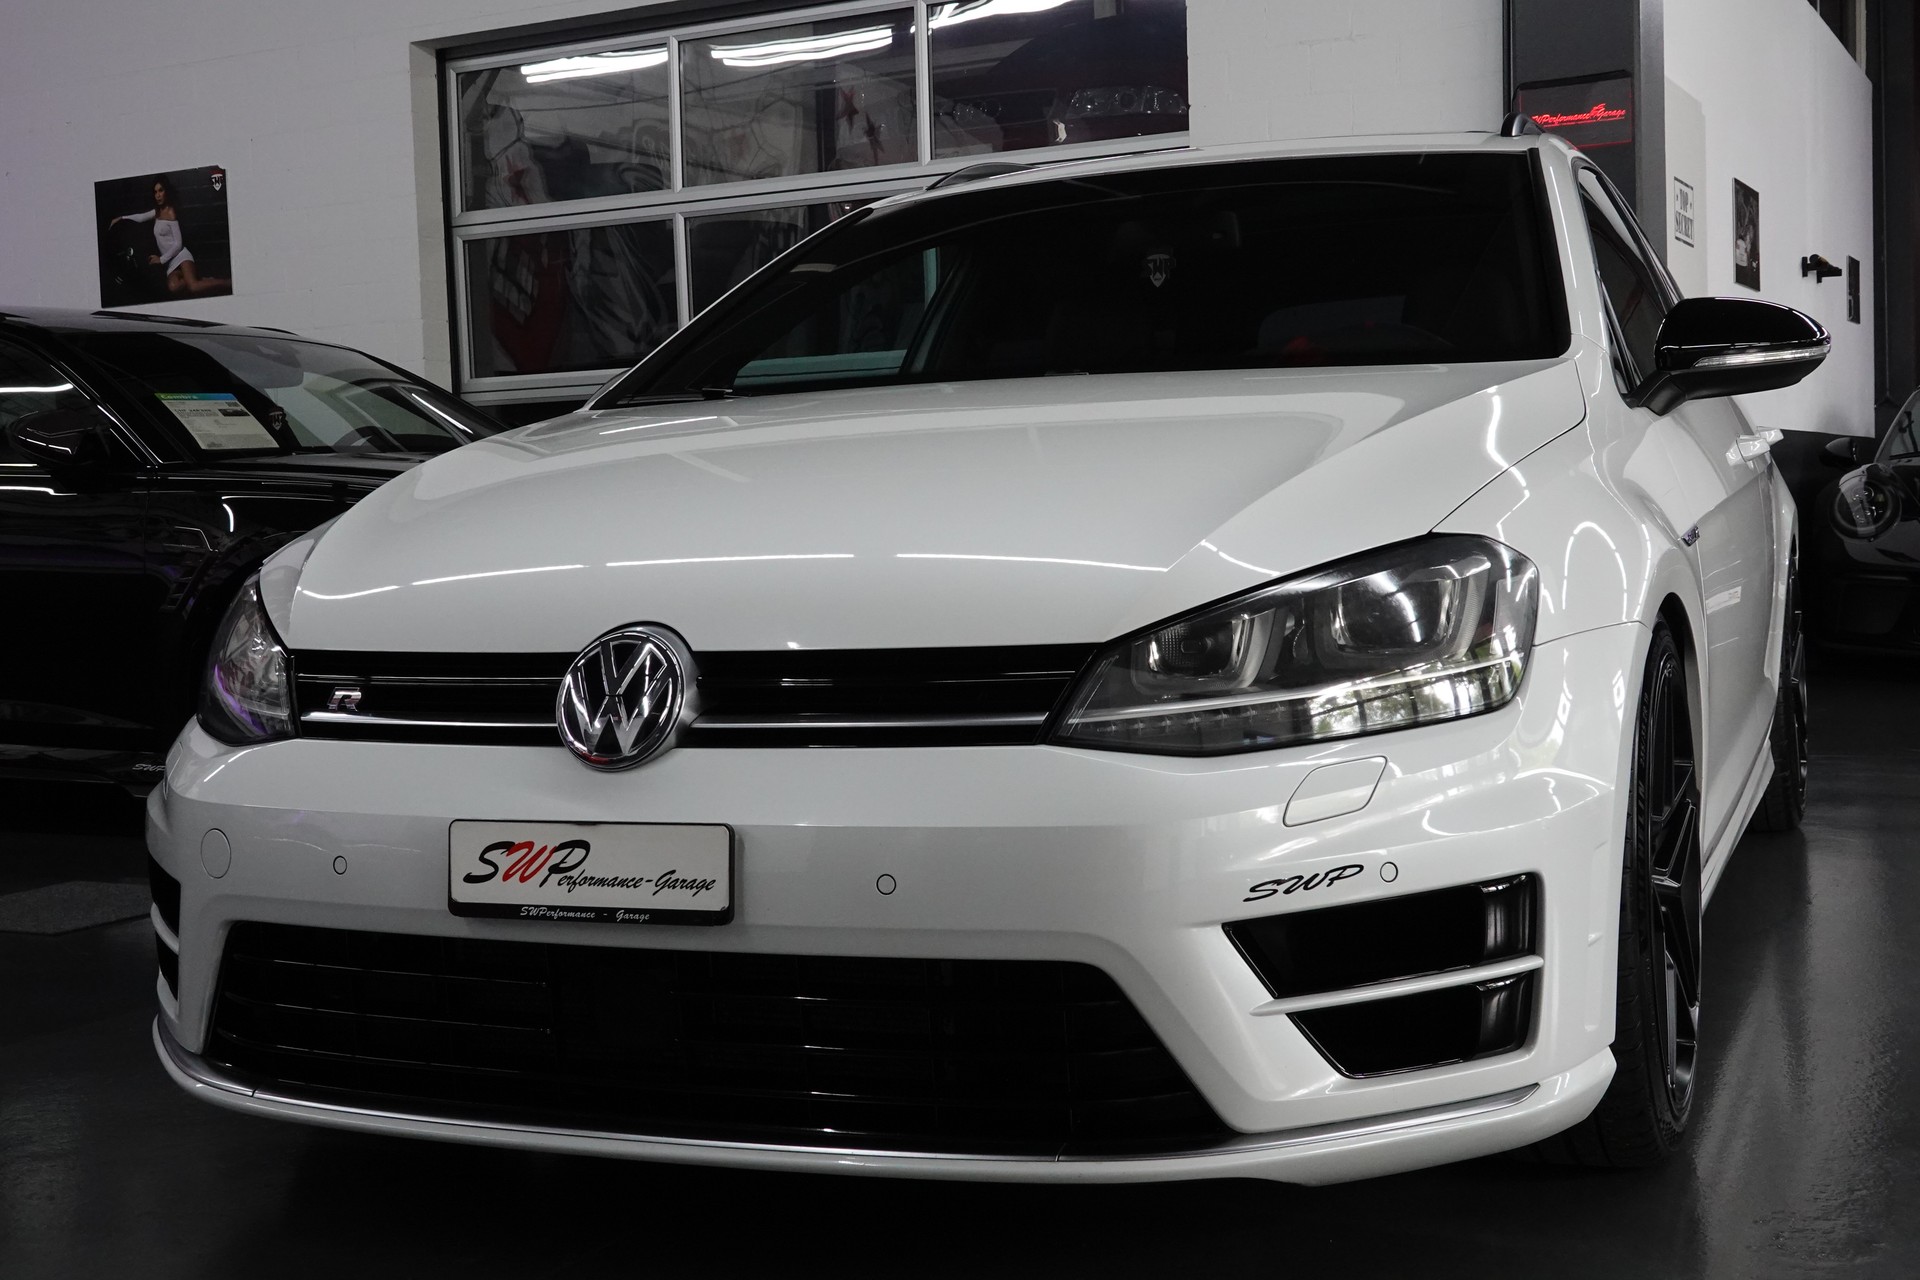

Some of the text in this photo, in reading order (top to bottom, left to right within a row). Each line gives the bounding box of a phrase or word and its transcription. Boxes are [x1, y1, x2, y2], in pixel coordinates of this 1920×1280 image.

[327, 687, 362, 712] R
[1243, 864, 1364, 903] SWP
[520, 906, 596, 919] SWPerformance
[616, 909, 650, 921] Garage
